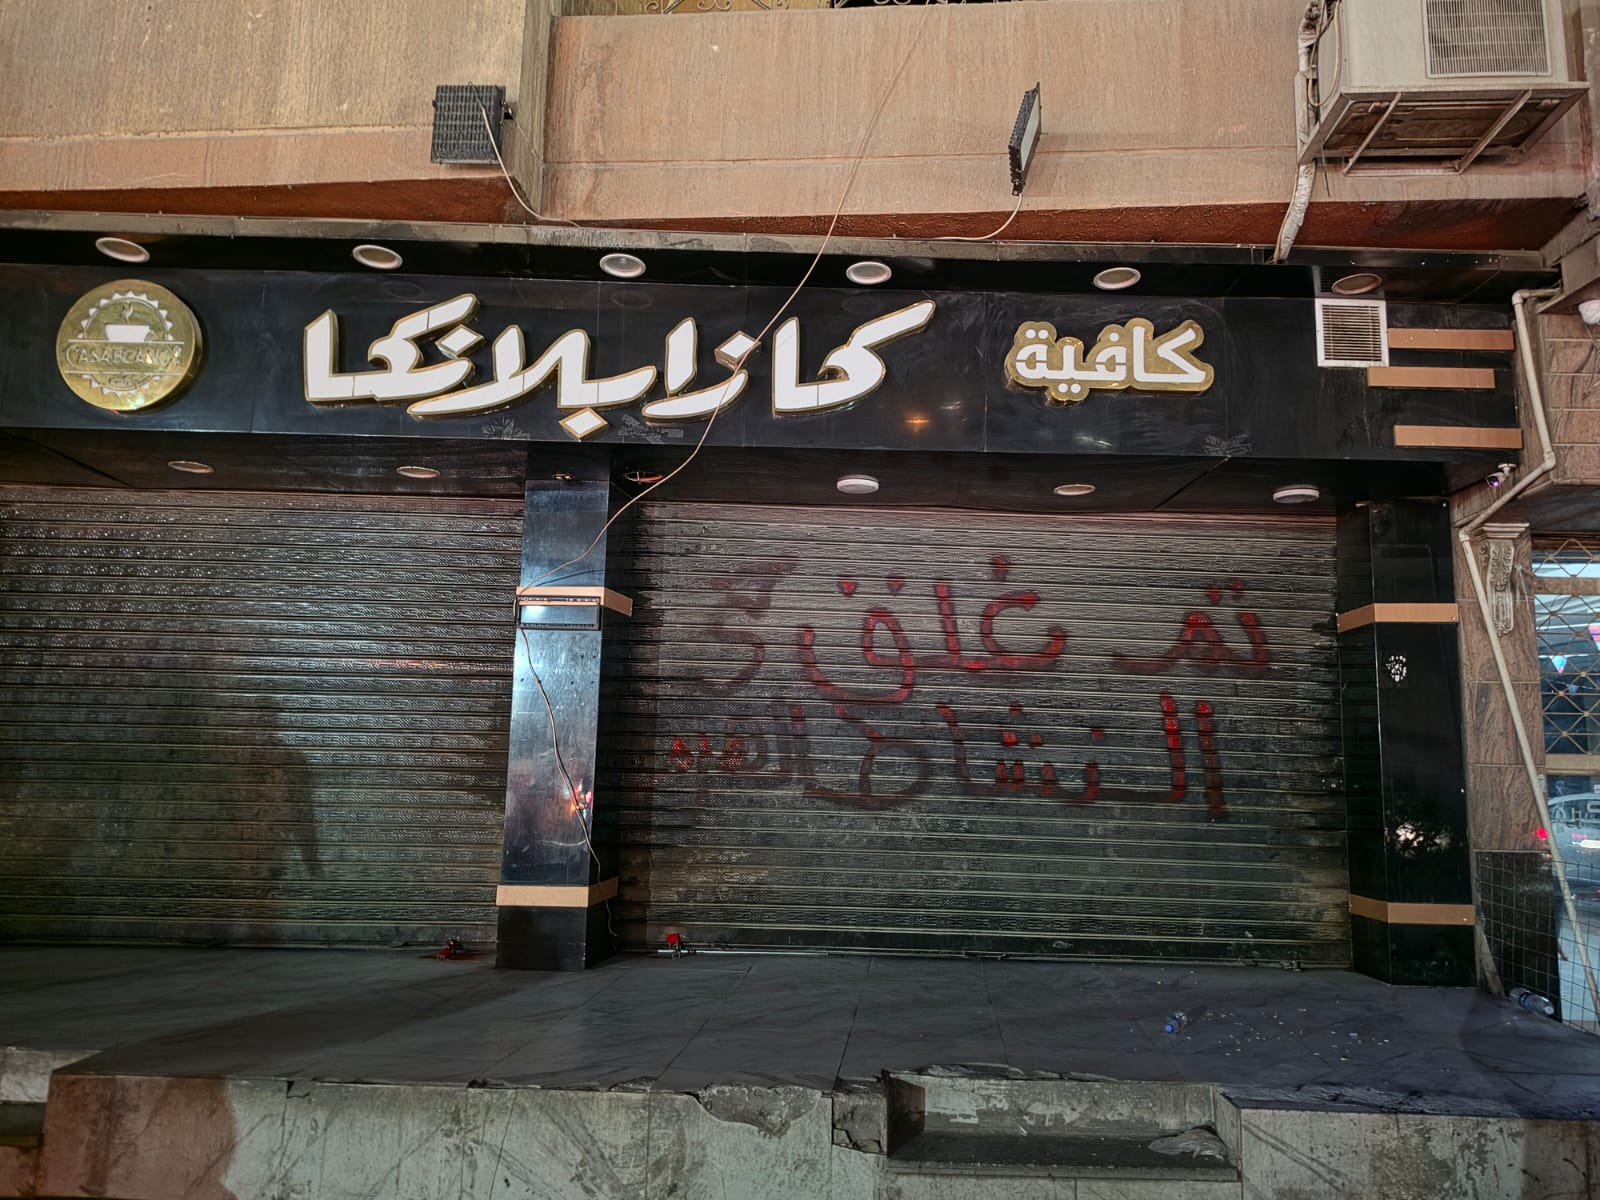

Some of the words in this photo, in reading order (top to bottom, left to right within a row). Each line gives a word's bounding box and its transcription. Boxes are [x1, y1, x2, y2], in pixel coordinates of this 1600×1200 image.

[65, 343, 183, 370] CASABLANCA
[304, 294, 937, 440] كازابلانكا
[1013, 324, 1208, 394] كافية
[801, 555, 1067, 703] غلق
[1111, 576, 1270, 676] تم
[804, 692, 1226, 820] النشاط
